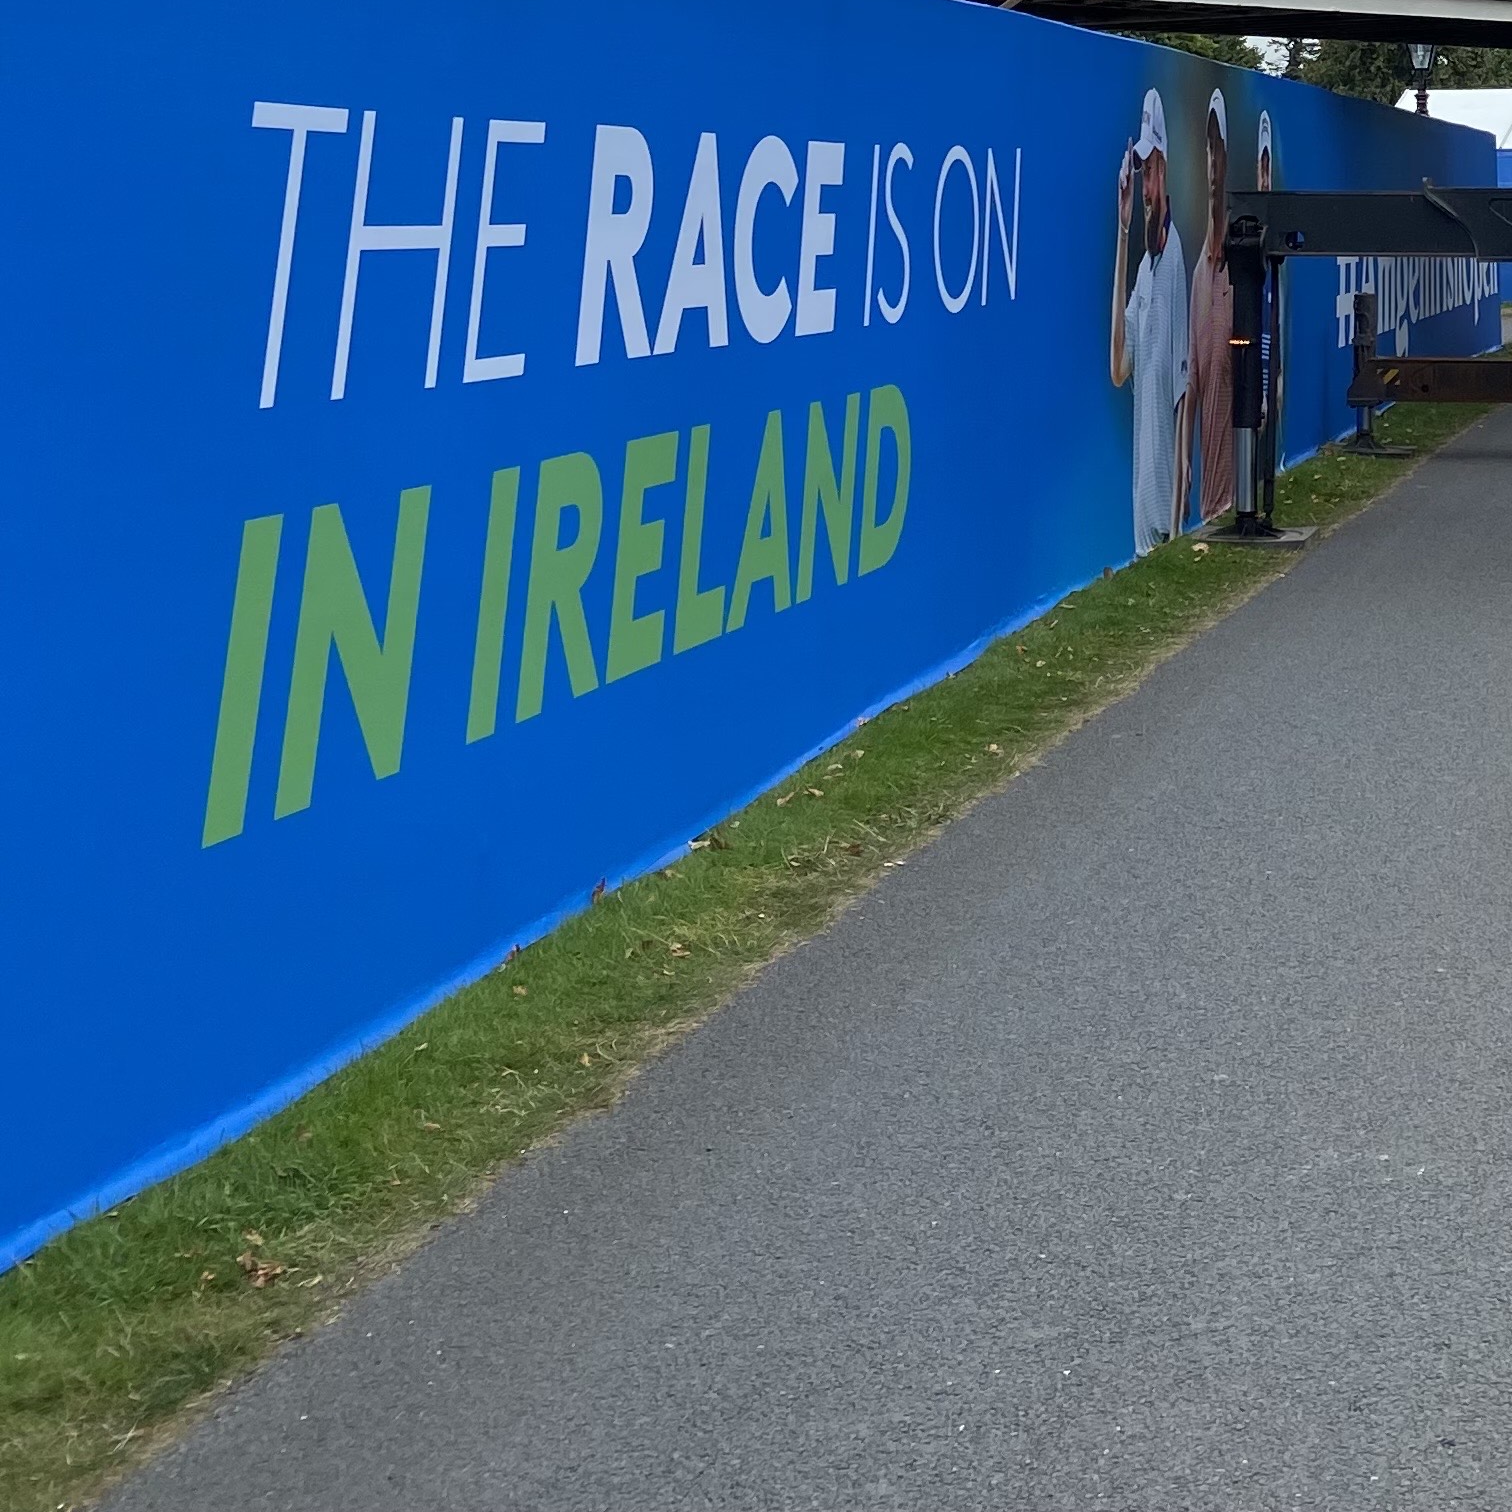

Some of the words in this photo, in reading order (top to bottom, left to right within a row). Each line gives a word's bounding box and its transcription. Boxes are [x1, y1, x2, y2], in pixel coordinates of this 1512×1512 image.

[251, 100, 547, 408] THE
[574, 123, 846, 366] RACE
[863, 141, 914, 327] IS
[933, 144, 1023, 314] ON
[201, 484, 432, 849] IN
[465, 383, 913, 746] IRELAND
